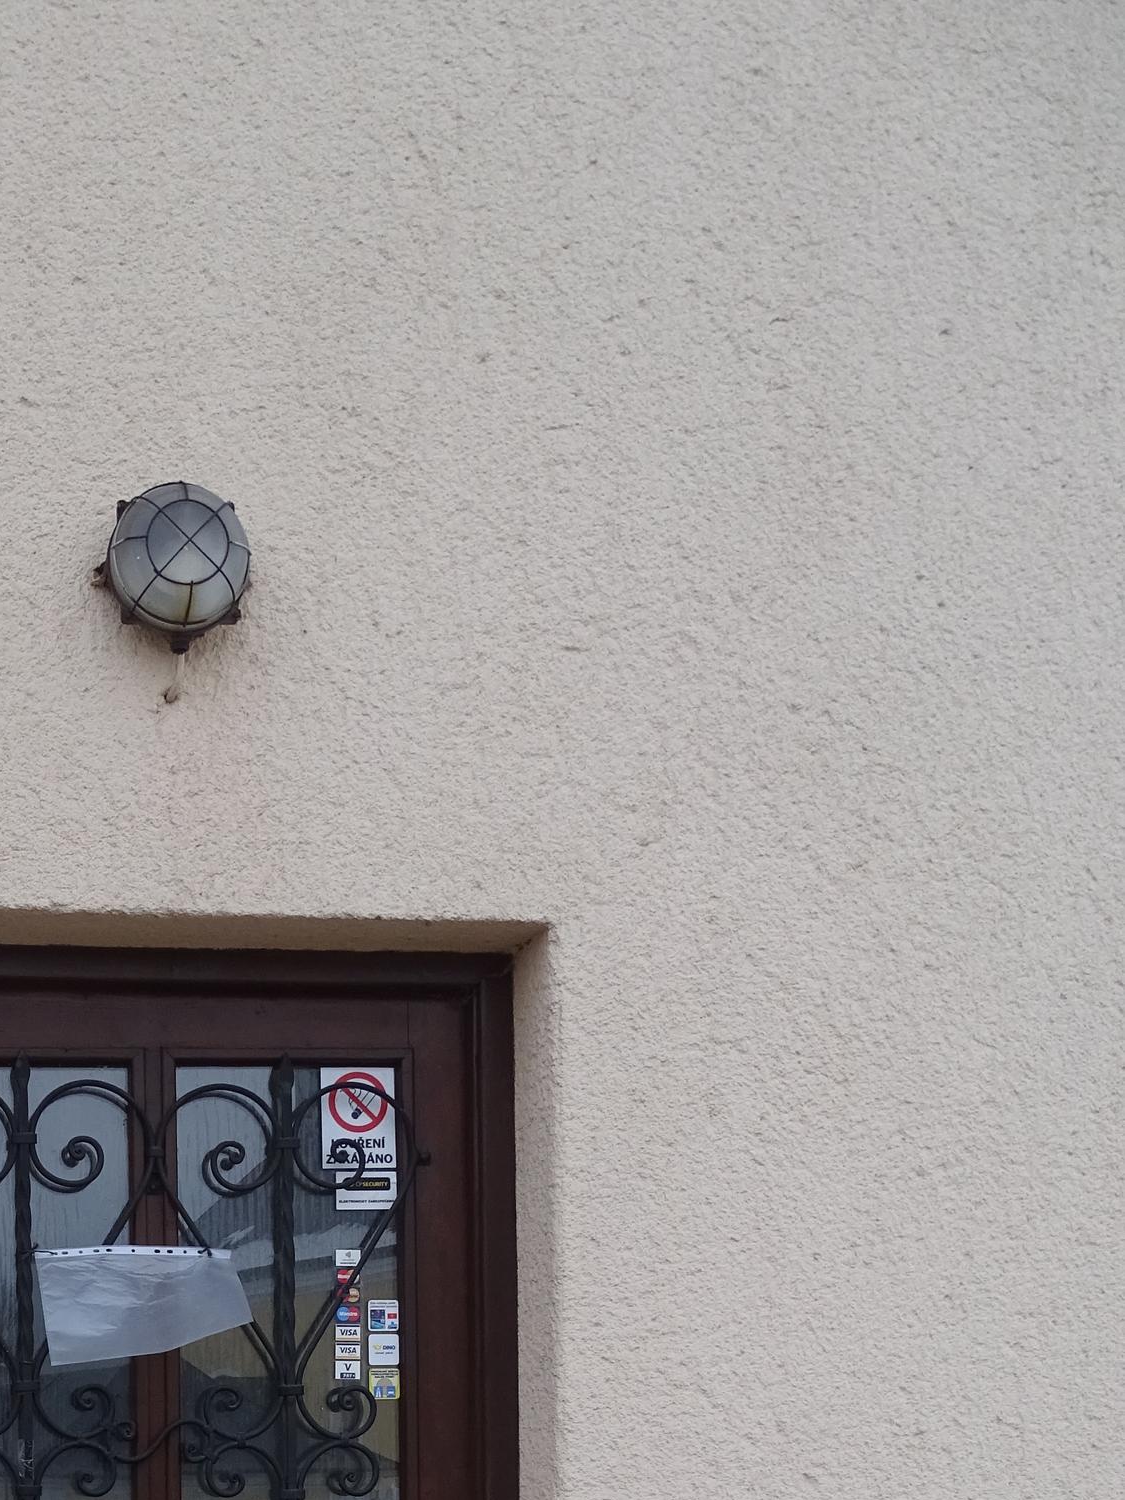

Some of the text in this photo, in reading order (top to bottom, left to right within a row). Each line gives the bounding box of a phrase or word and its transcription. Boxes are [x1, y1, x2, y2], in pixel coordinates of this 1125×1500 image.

[339, 1328, 358, 1336] VISA
[339, 1346, 357, 1354] VISA
[344, 1363, 352, 1372] V
